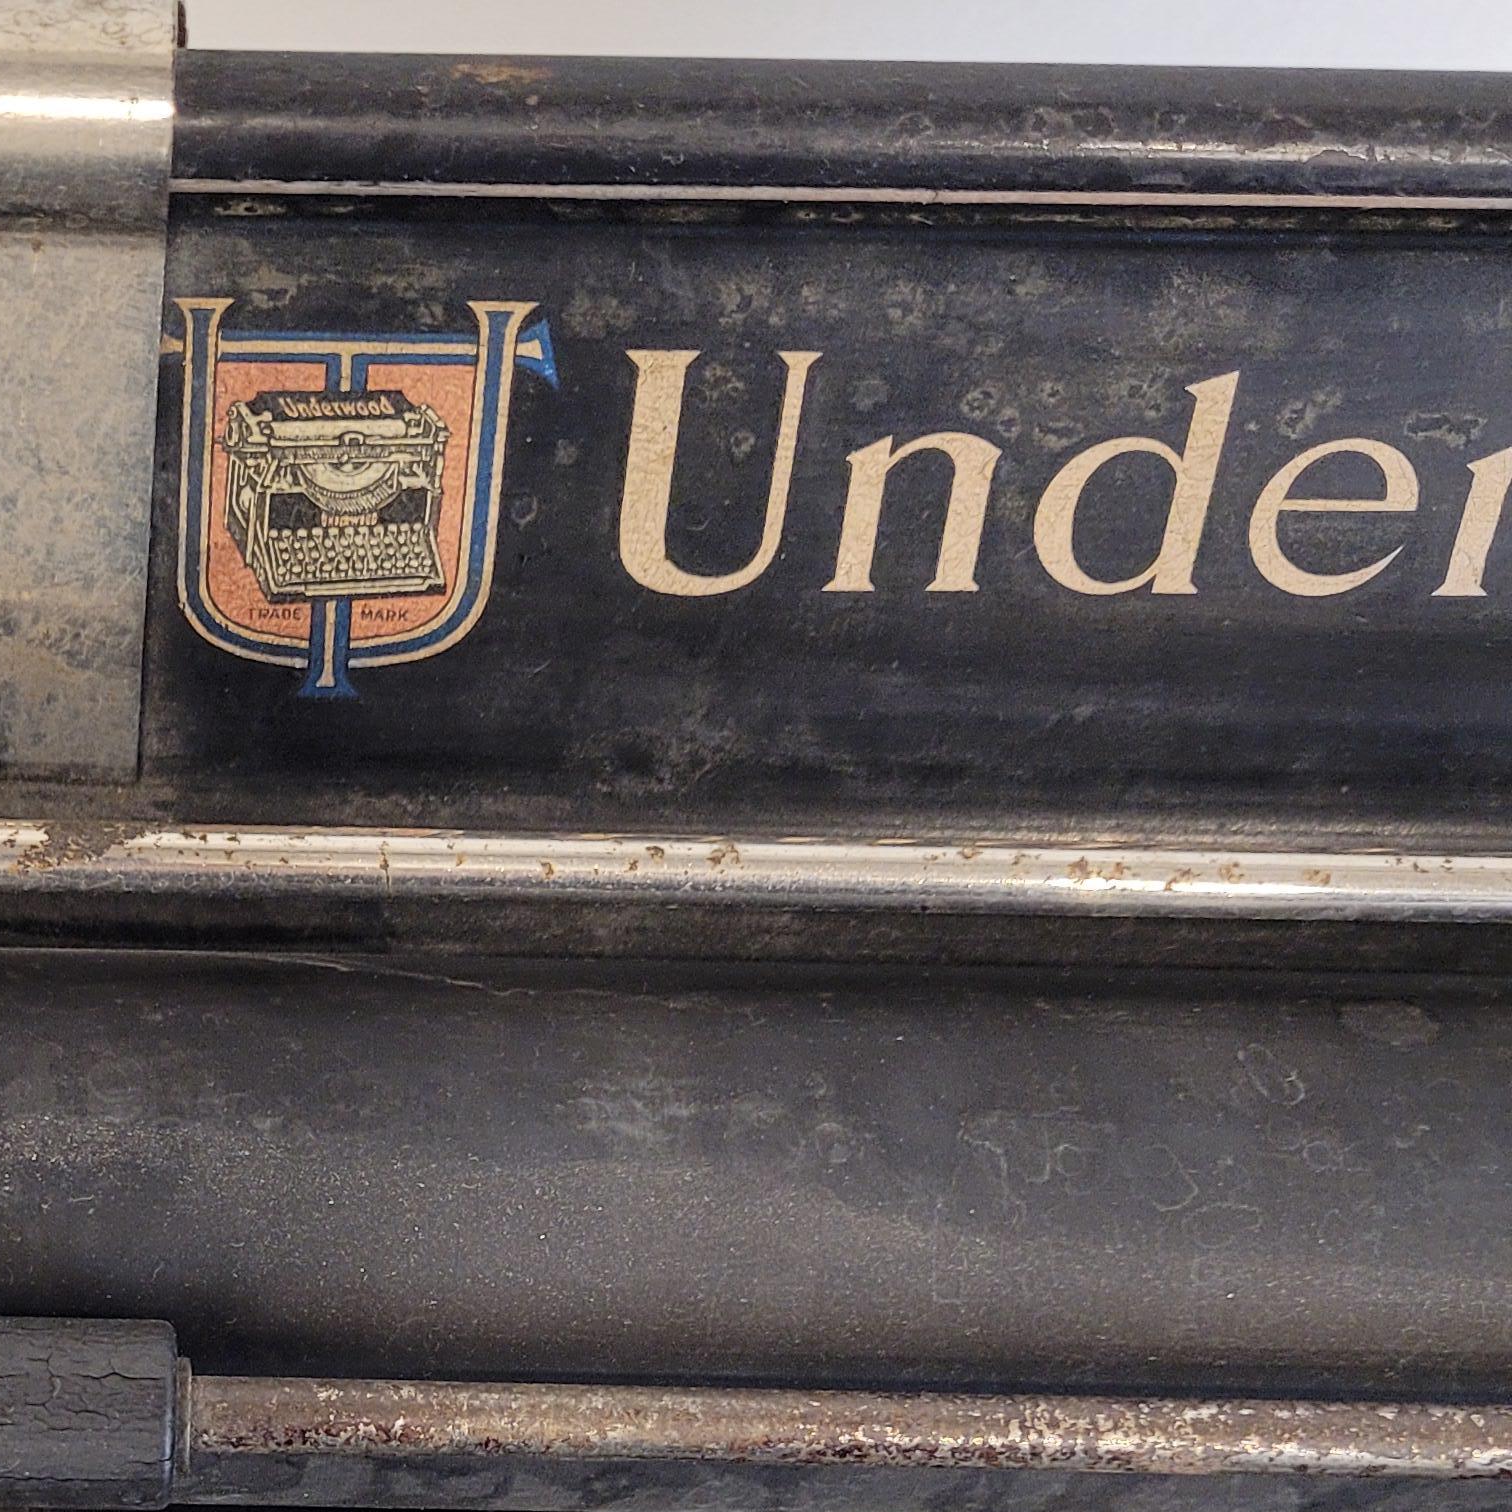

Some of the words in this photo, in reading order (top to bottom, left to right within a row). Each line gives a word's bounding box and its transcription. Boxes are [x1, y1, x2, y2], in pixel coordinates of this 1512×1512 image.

[279, 396, 395, 417] Underwood
[620, 350, 1512, 596] Under
[249, 607, 302, 621] TRADE
[360, 608, 410, 622] MARK
